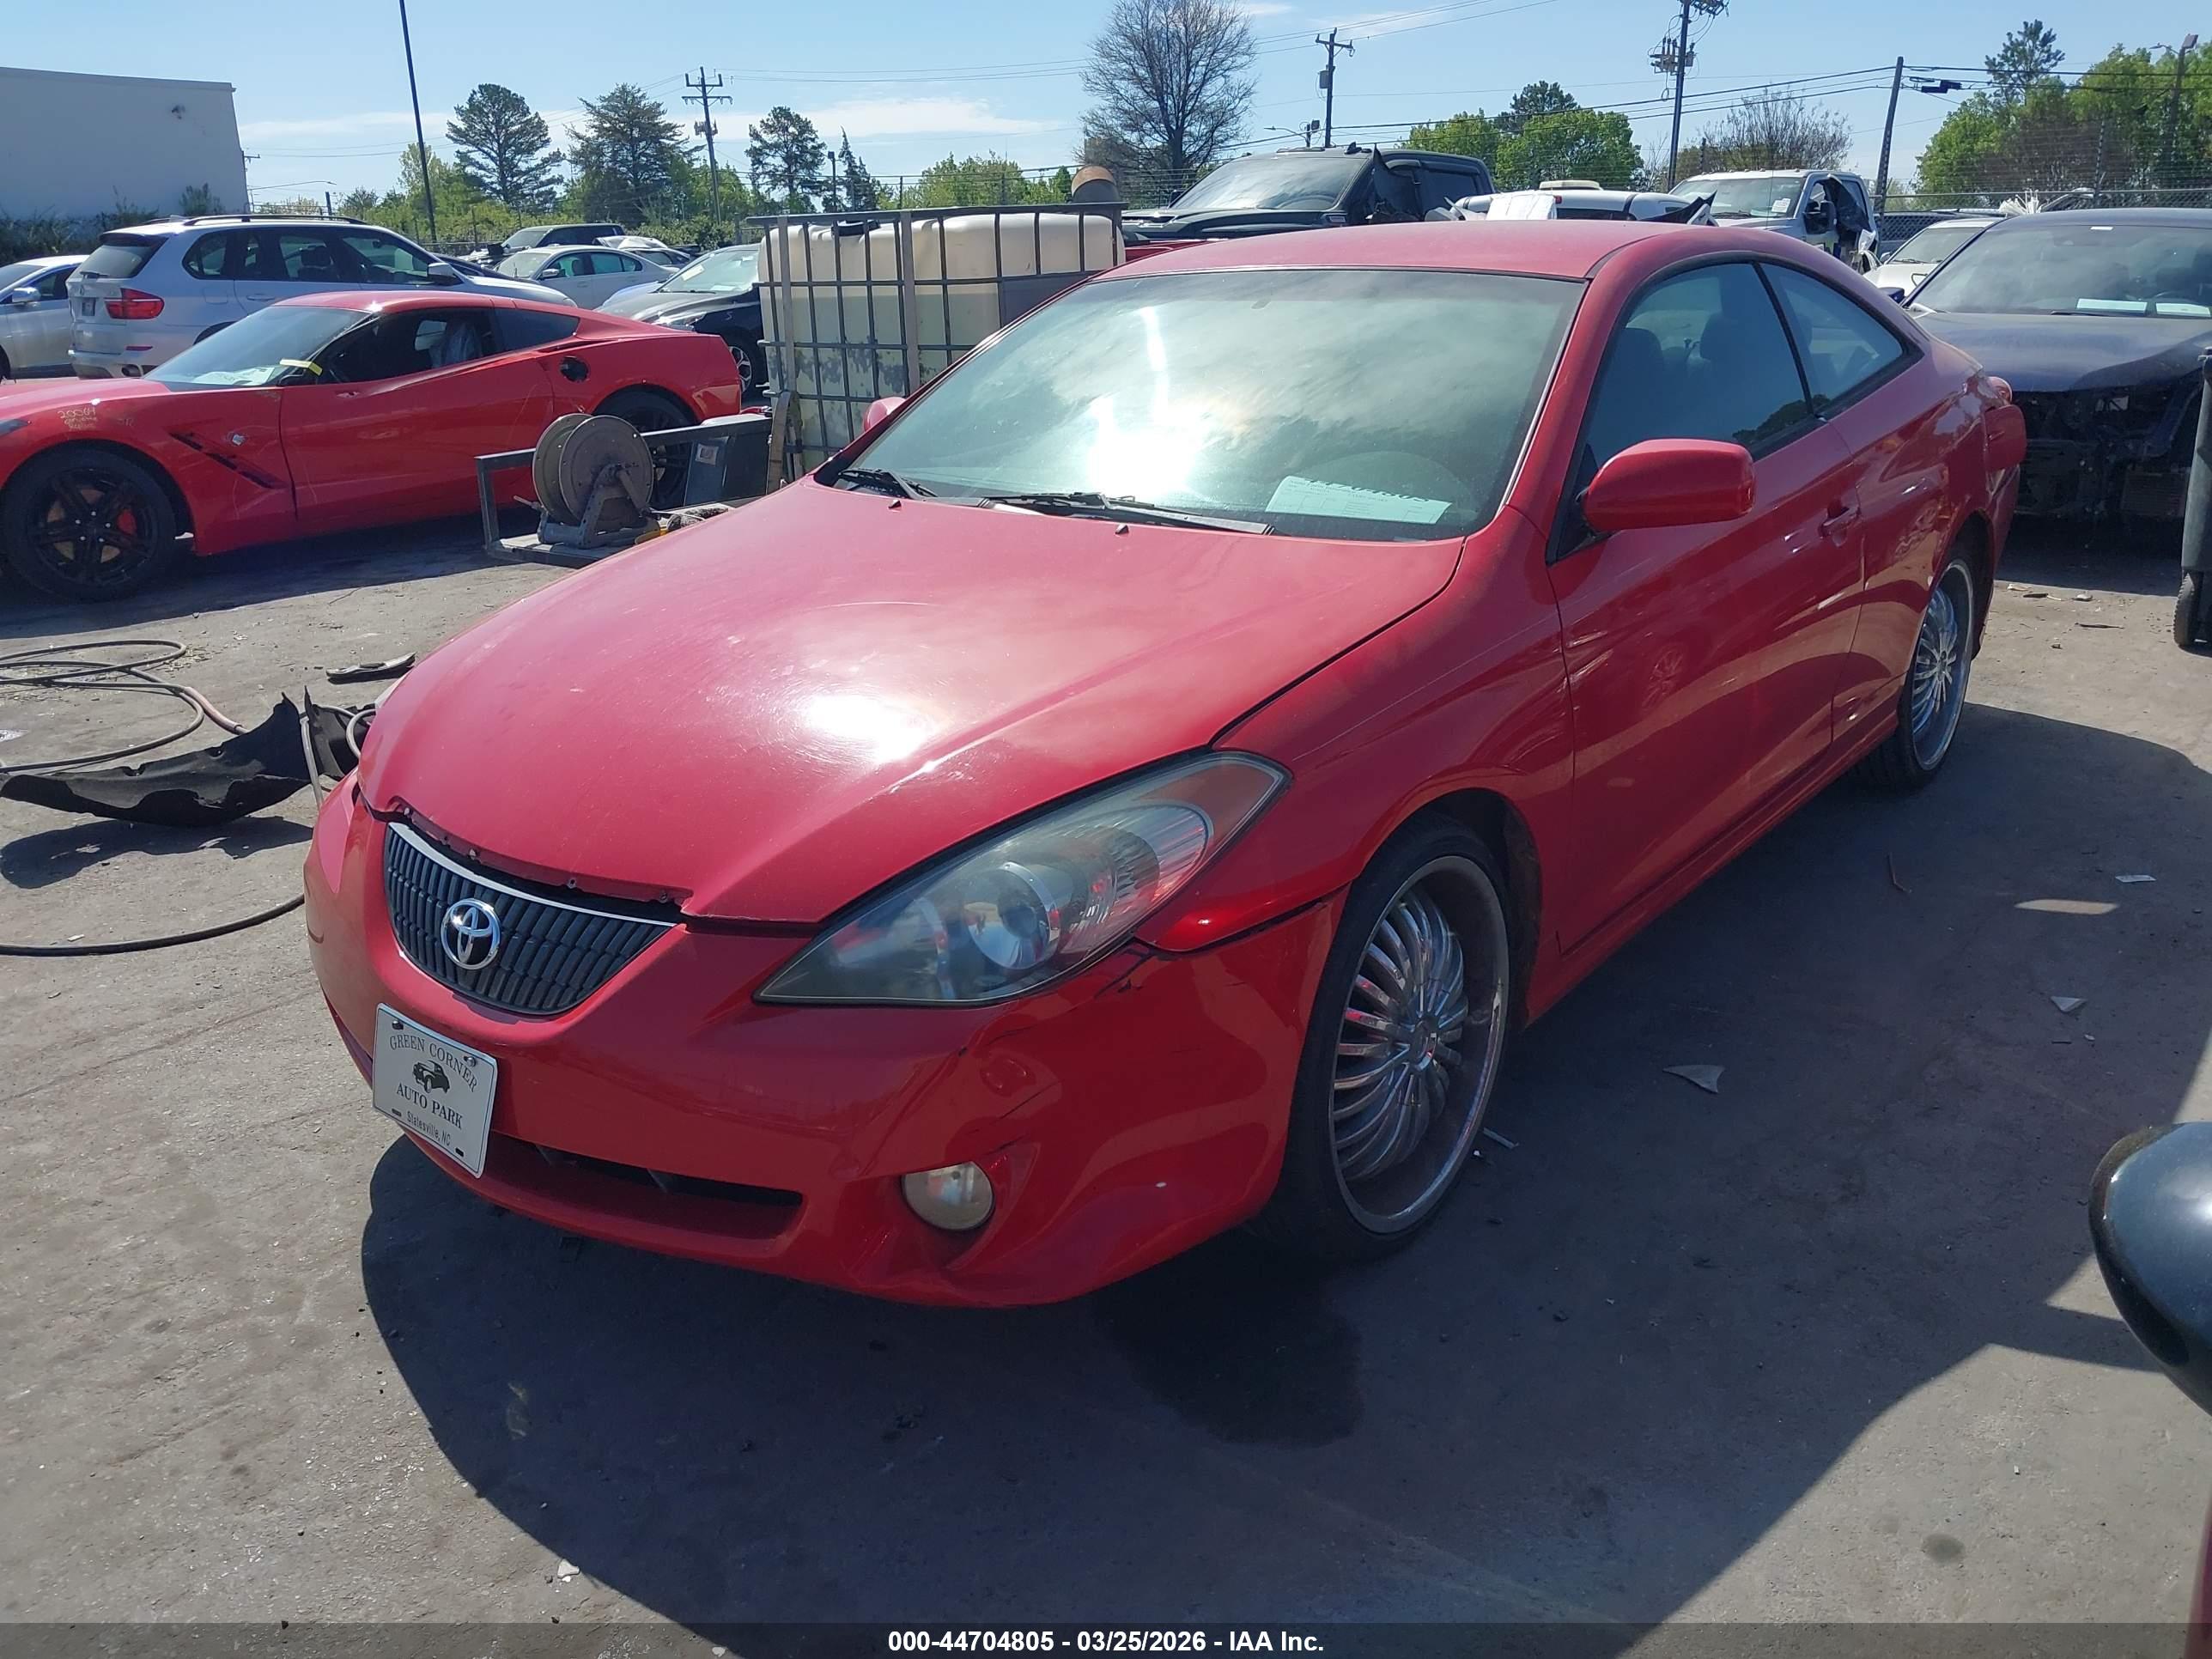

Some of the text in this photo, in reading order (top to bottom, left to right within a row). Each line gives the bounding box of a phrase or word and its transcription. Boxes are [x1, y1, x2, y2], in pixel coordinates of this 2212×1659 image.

[389, 1034, 477, 1092] GREEN CORNER
[396, 1082, 464, 1129] AUTO PARK
[441, 1130, 452, 1146] NC
